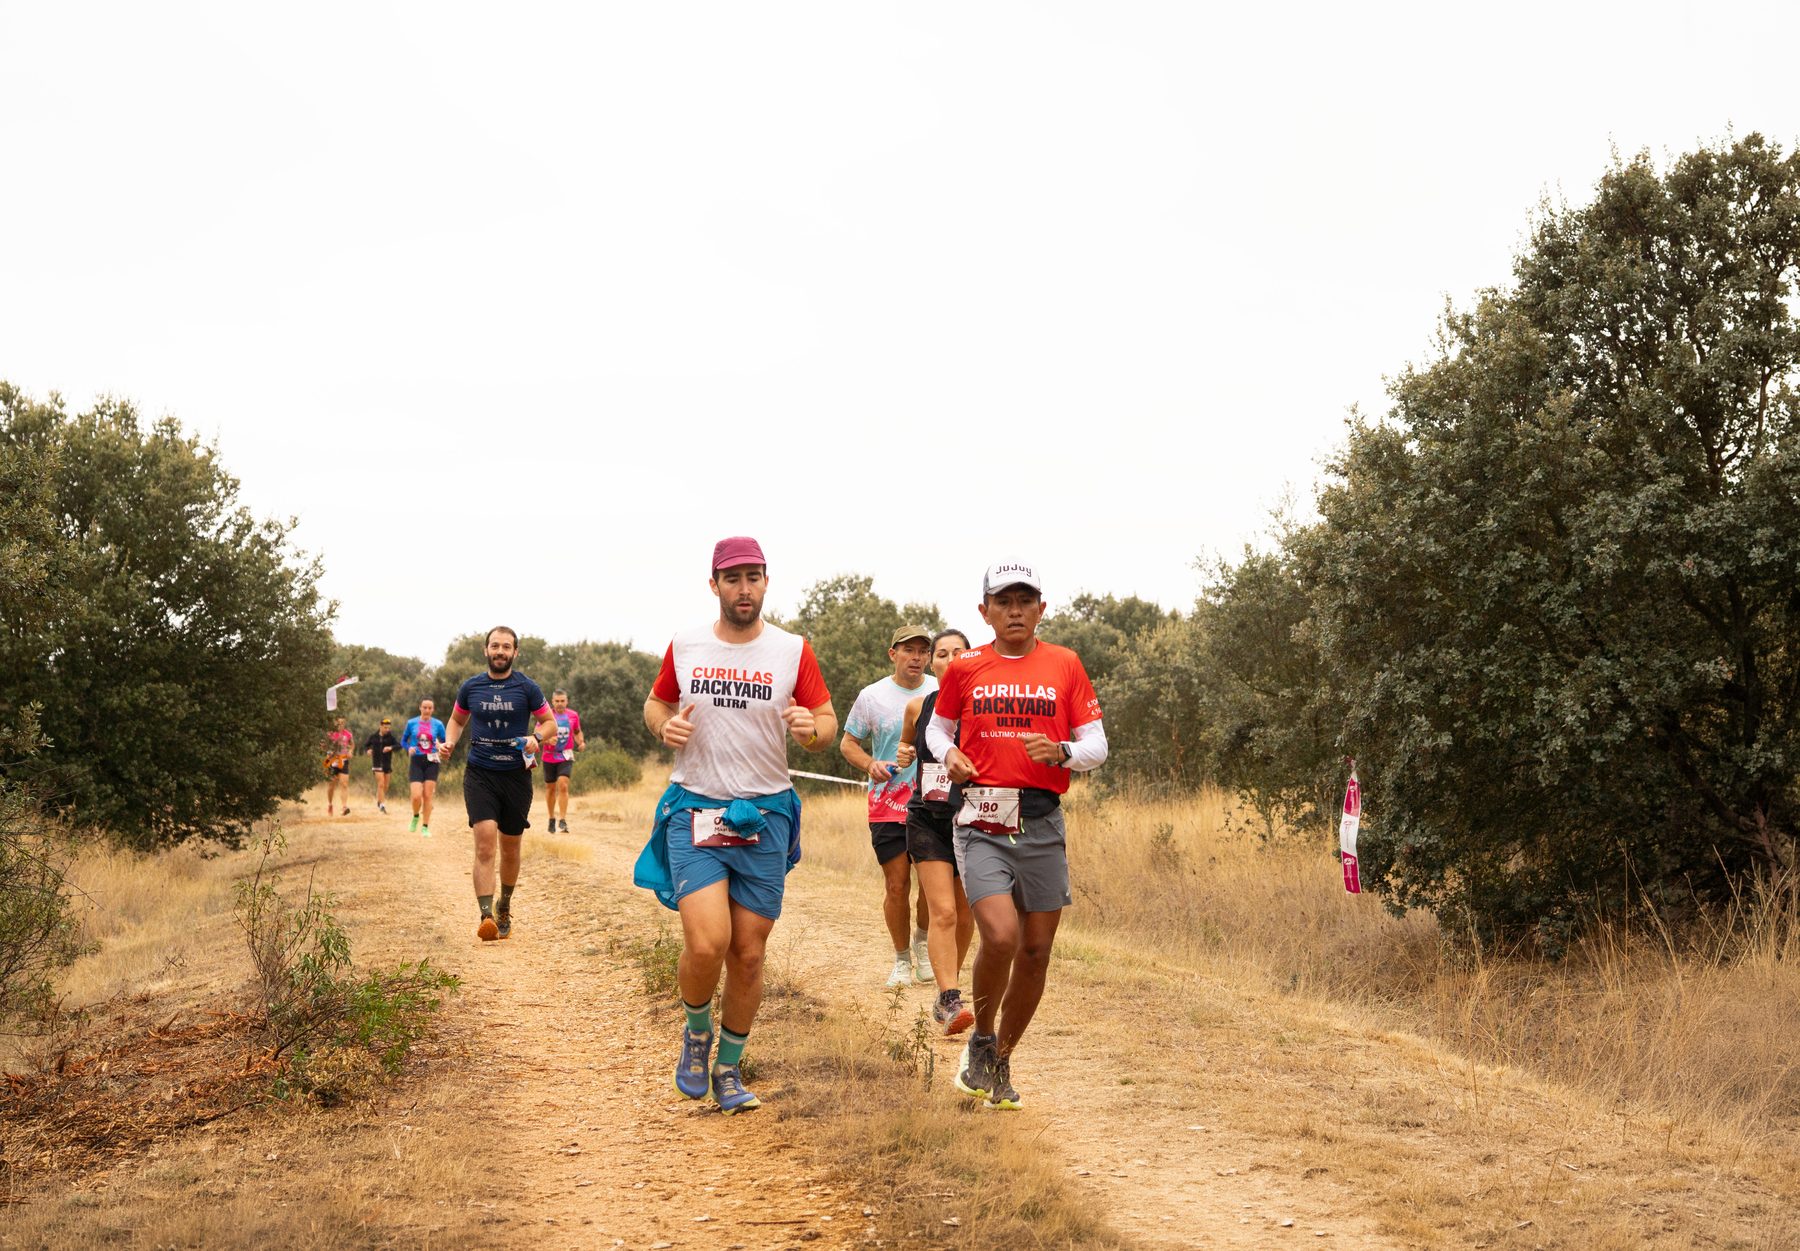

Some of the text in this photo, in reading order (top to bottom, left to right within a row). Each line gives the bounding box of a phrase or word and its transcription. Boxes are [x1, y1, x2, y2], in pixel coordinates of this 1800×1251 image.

[692, 667, 773, 685] CURILLAS
[690, 679, 773, 701] BACKYARD
[972, 684, 1057, 700] CURILLAS
[480, 701, 514, 711] TRAIL
[973, 697, 1056, 717] BACKYARD
[990, 730, 1016, 738] ÚLTIMO
[979, 802, 999, 812] 180
